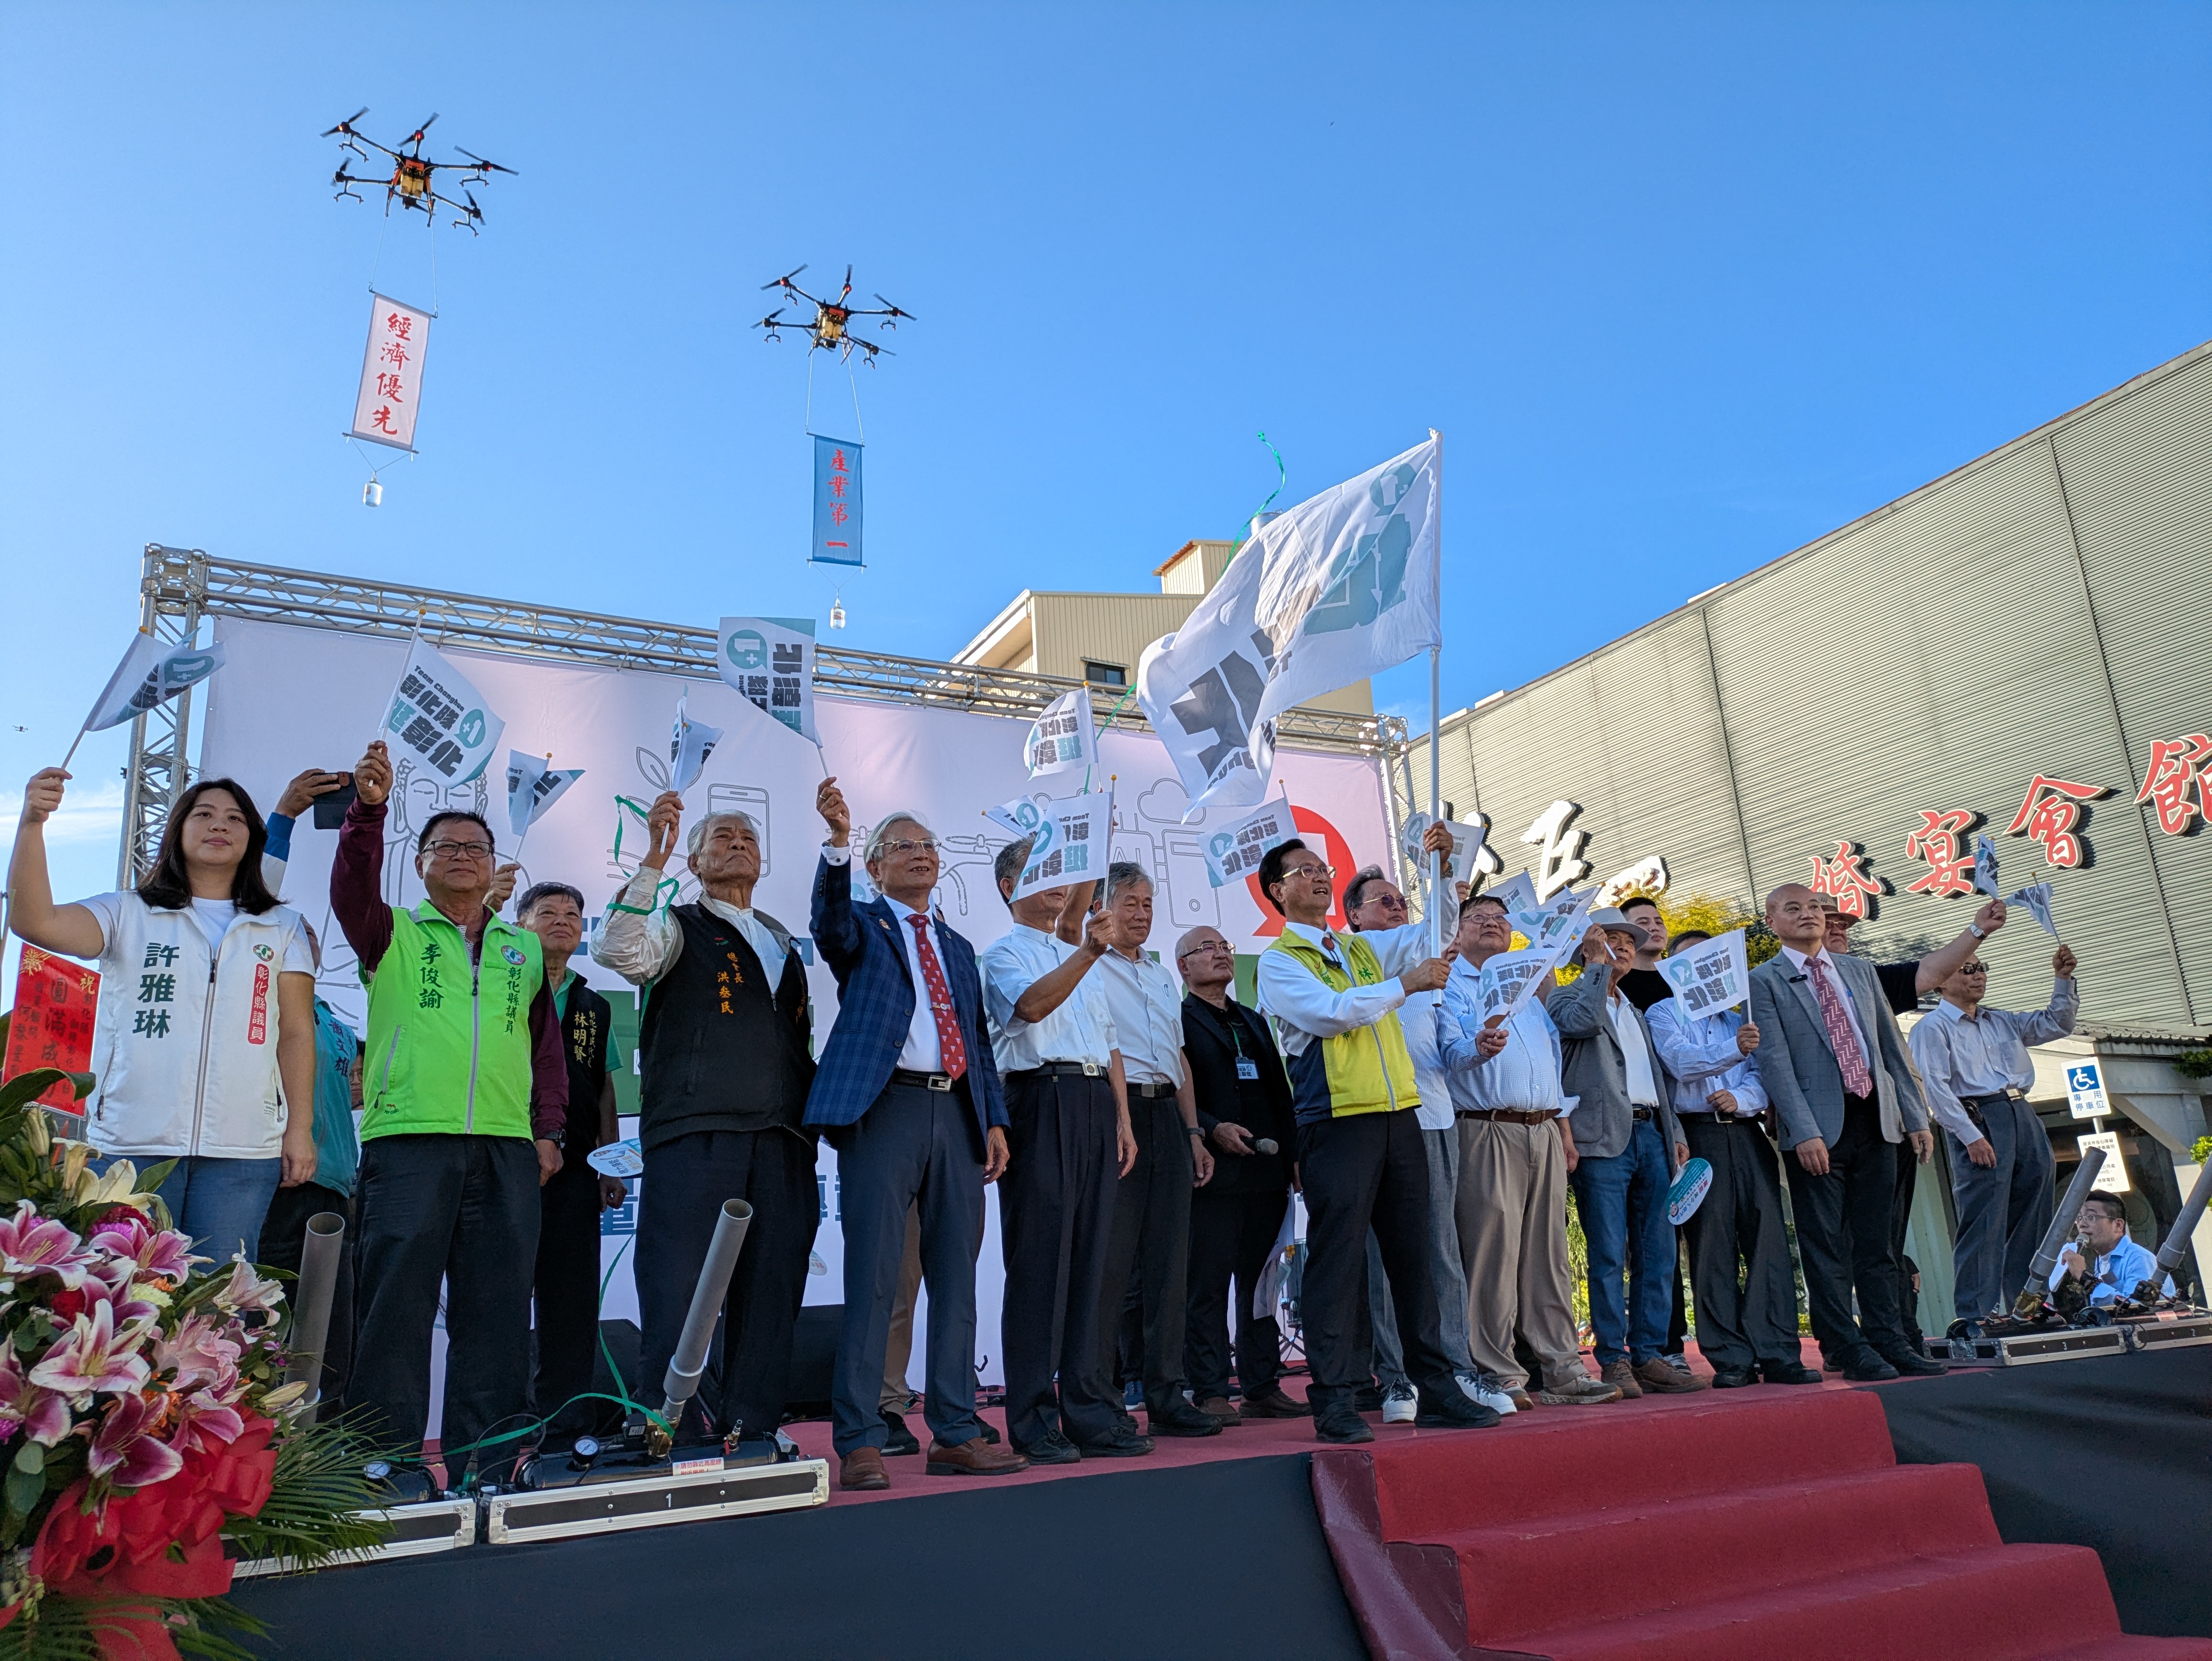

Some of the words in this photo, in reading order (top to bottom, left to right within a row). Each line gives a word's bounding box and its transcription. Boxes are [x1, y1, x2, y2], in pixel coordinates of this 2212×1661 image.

[372, 312, 412, 435] 經濟優先
[827, 449, 849, 548] 產業第一
[400, 673, 460, 731] 彰化隊
[414, 665, 434, 685] Team
[433, 683, 465, 712] Changhua
[1808, 732, 2212, 919] 婚宴會館
[79, 972, 95, 995] 祝
[133, 942, 180, 1039] 許雅琳
[250, 966, 268, 1041] 彰化縣議員
[419, 943, 444, 1009] 李俊諭
[505, 966, 521, 1036] 彰化縣議員
[574, 1010, 589, 1063] 林明賢
[2073, 1090, 2102, 1101] 專用
[2076, 1100, 2105, 1111] 停車位
[2063, 1341, 2068, 1351] 3
[666, 1493, 672, 1508] 1
